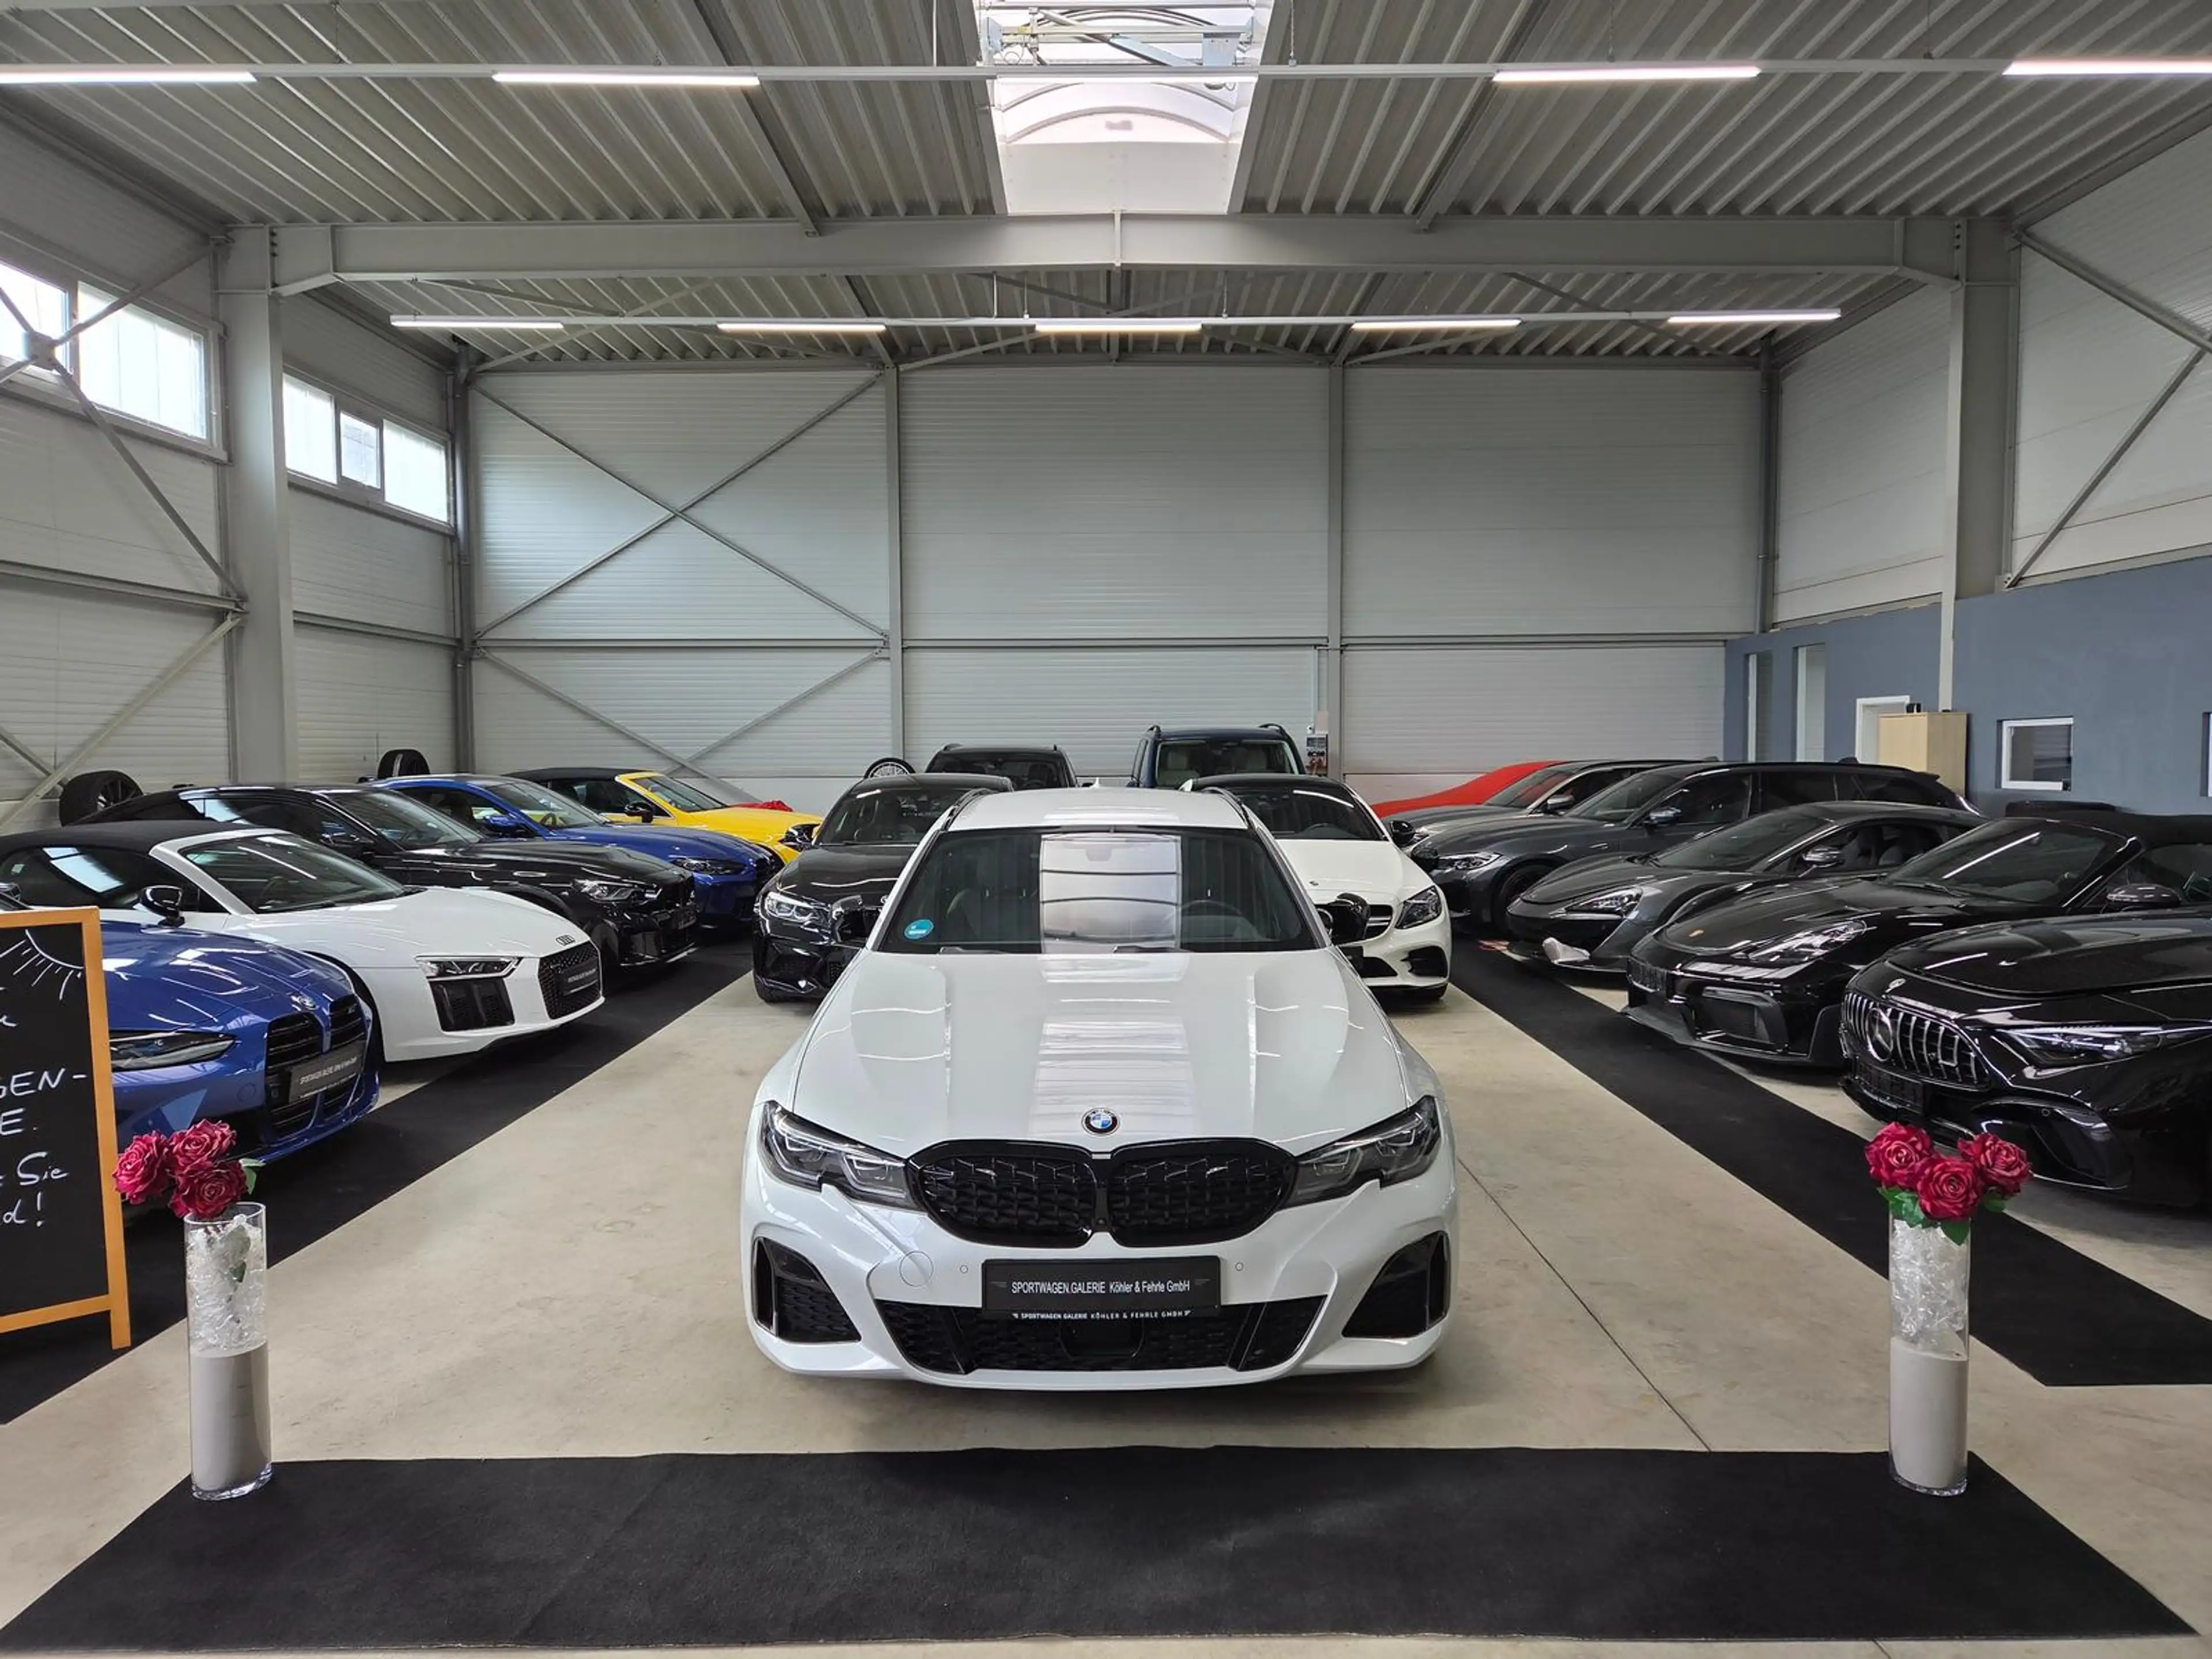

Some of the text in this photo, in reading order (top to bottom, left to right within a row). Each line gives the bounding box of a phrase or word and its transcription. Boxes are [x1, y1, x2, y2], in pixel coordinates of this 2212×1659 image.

[16, 1151, 70, 1186] Sie
[1109, 1281, 1133, 1293] Köhler
[1134, 1280, 1141, 1293] &
[1142, 1280, 1165, 1293] Fehrle
[1166, 1279, 1191, 1292] GmbH
[1090, 1311, 1120, 1320] KÖHLER
[1161, 1310, 1183, 1318] GMBH
